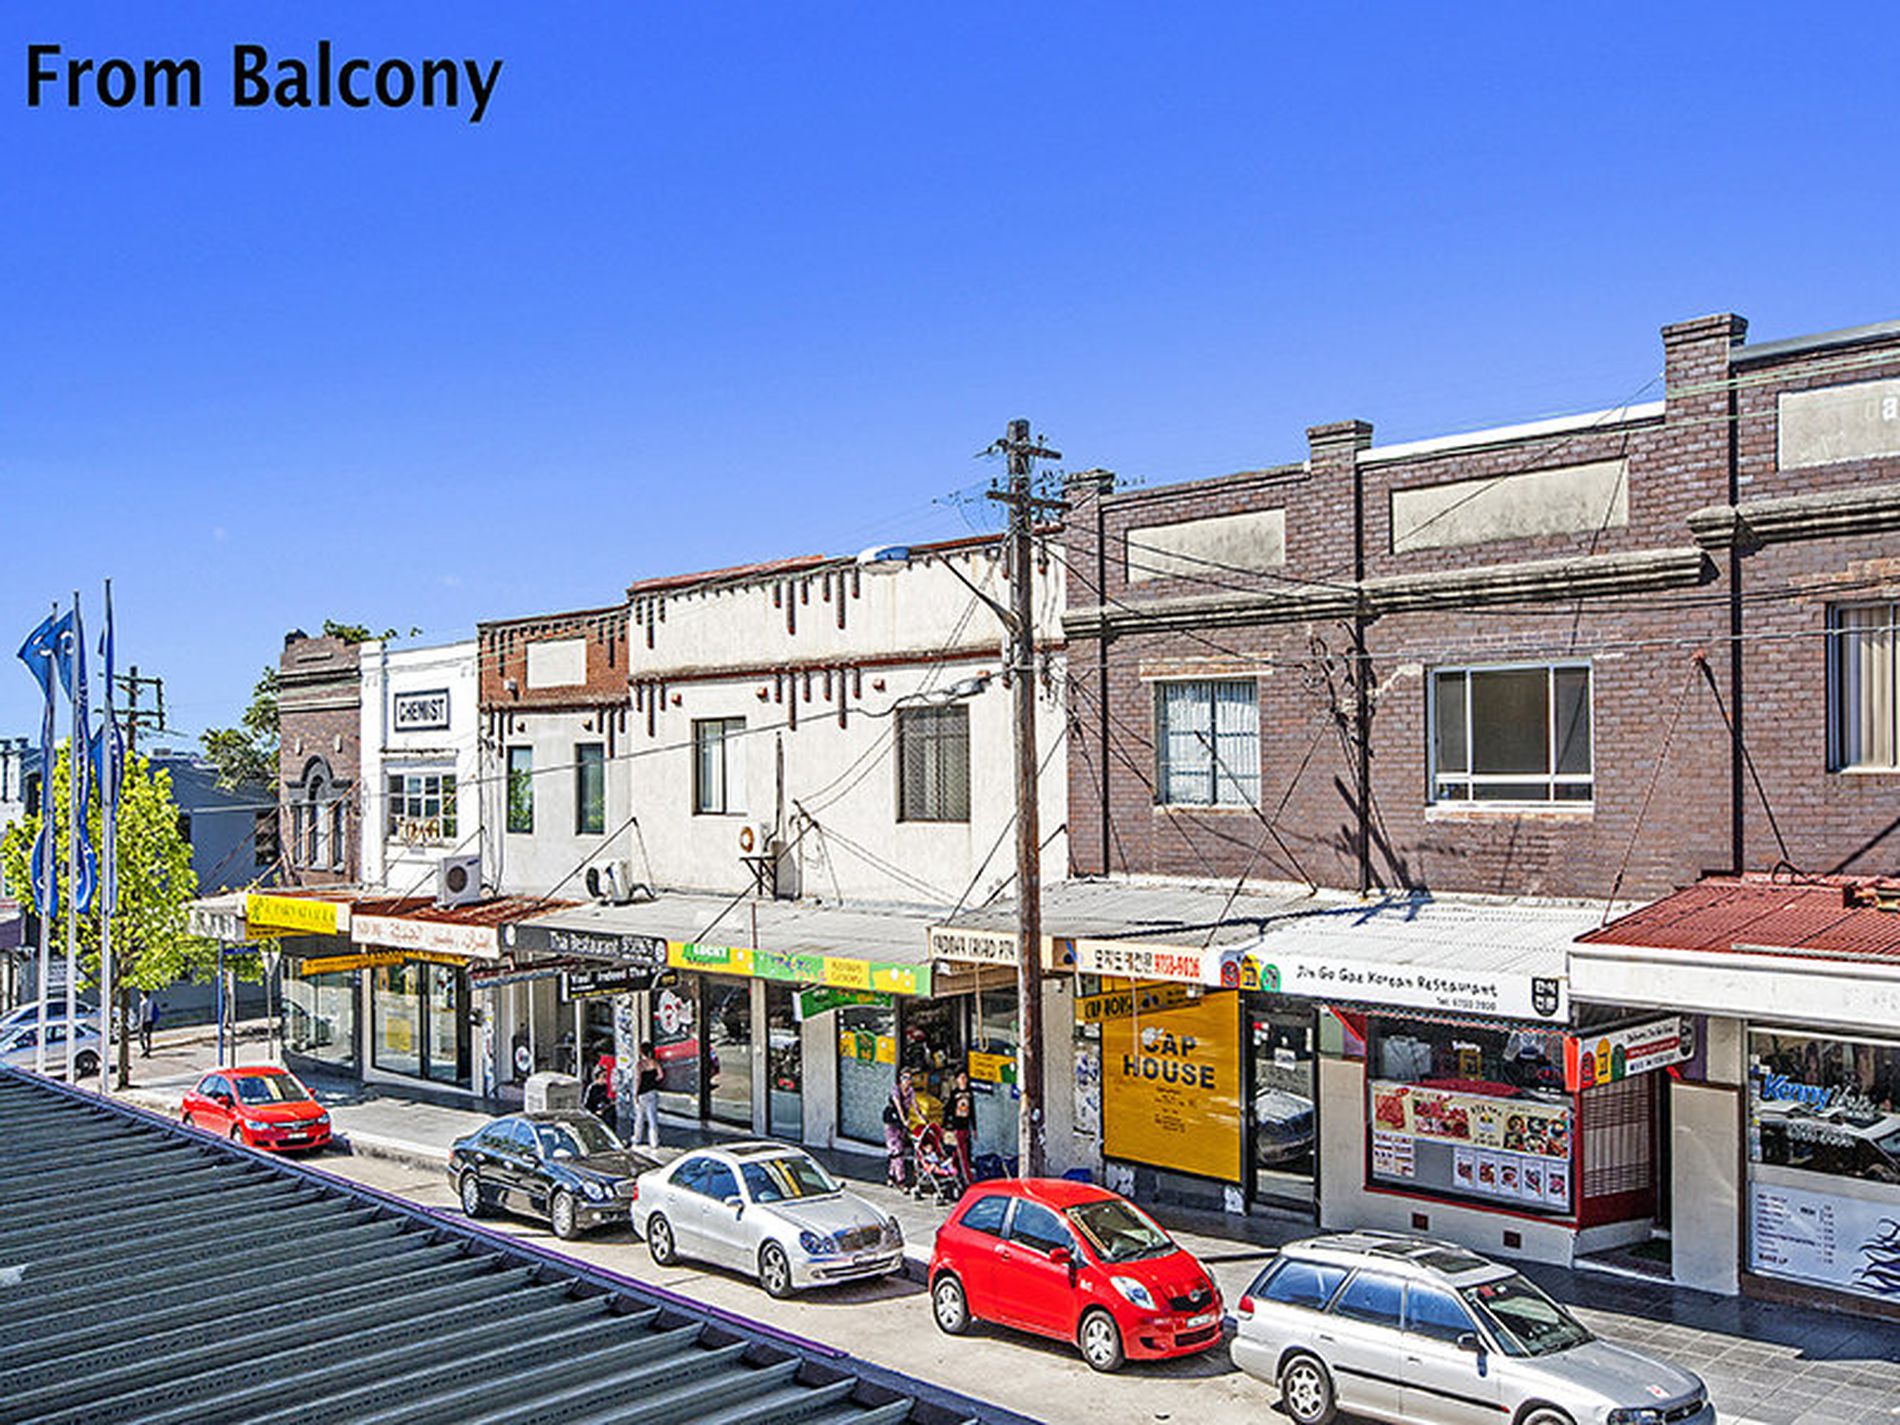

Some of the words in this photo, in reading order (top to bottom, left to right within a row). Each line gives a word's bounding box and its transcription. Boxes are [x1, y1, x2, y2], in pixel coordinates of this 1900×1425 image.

[399, 697, 445, 722] CHEMIST
[1296, 965, 1316, 980] Jin
[1319, 966, 1336, 981] Go
[1367, 970, 1414, 990] Korean
[1417, 975, 1498, 998] Restaurant
[1142, 1029, 1198, 1057] CAP
[1123, 1054, 1216, 1090] HOUSE
[1762, 1072, 1833, 1112] Kenny
